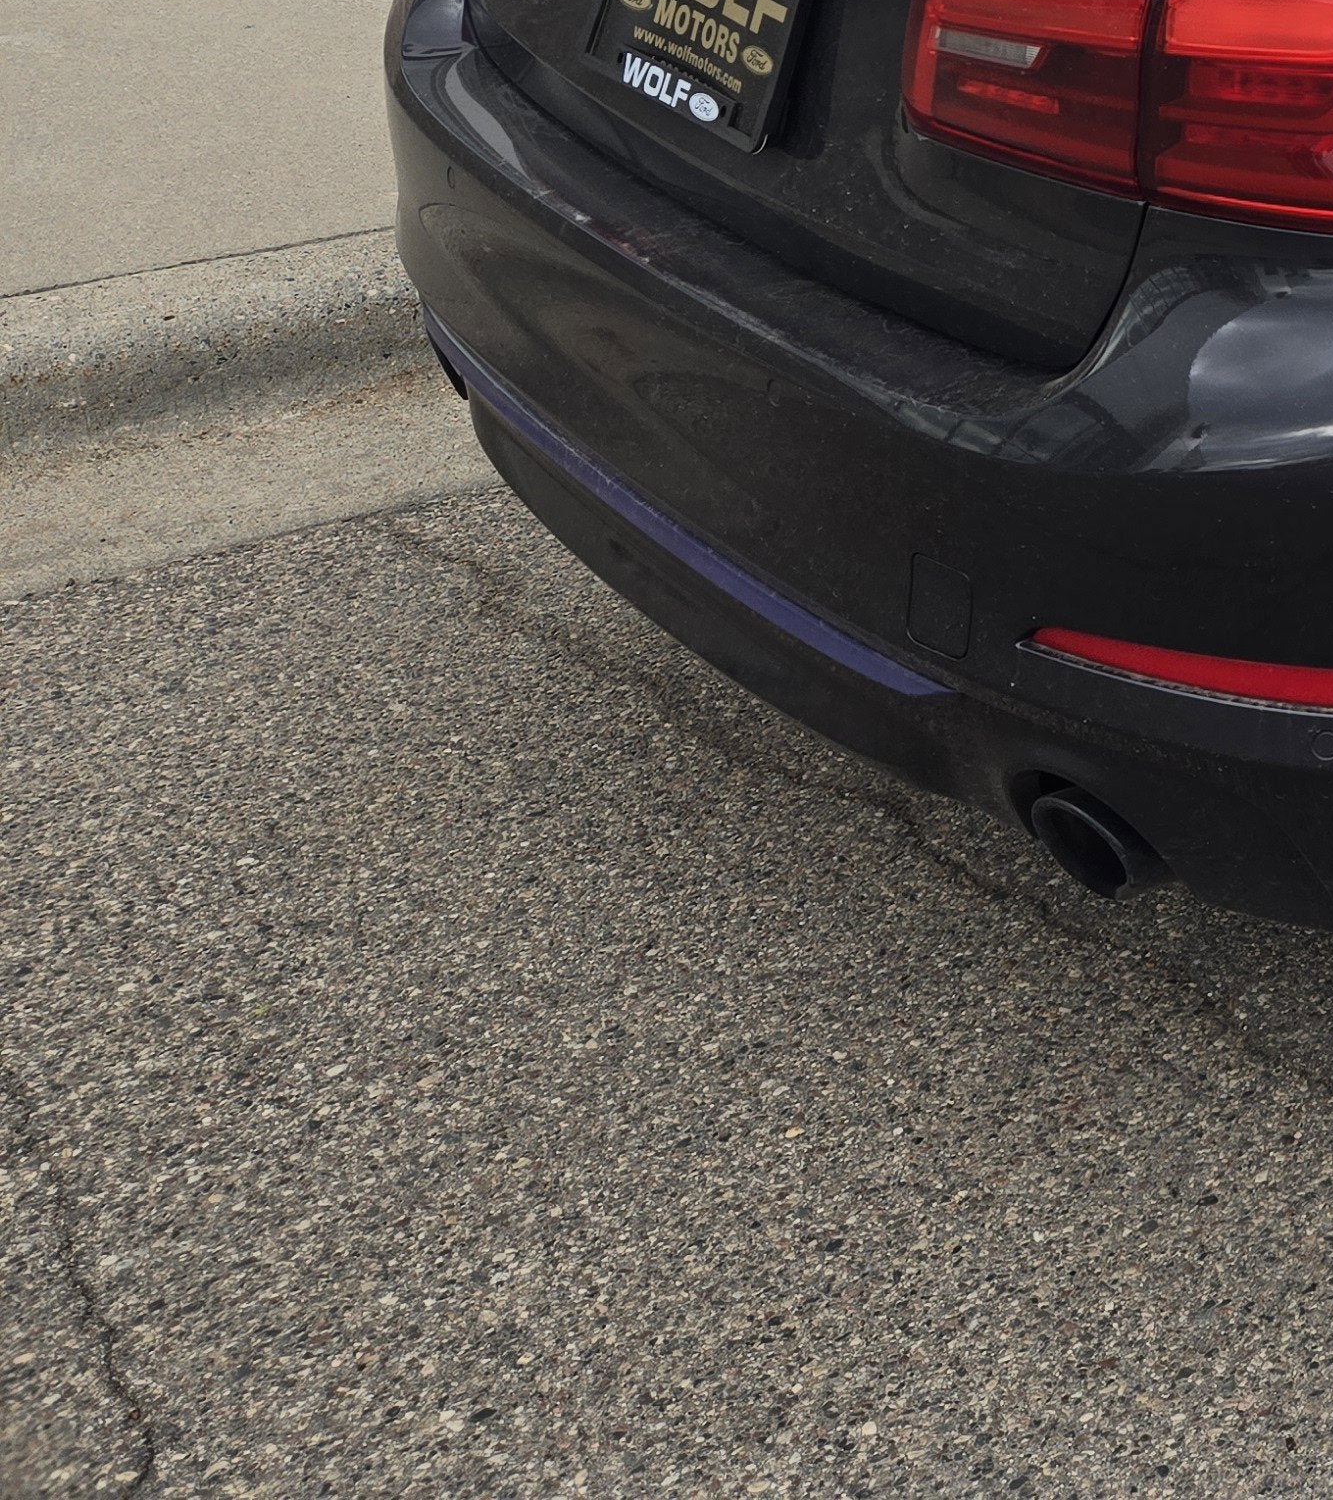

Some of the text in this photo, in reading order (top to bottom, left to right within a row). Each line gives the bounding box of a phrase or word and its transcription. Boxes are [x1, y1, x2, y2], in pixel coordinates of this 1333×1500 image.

[622, 52, 691, 108] WOLF
[633, 25, 742, 94] www.wolfmotors.com
[745, 48, 769, 72] Ford
